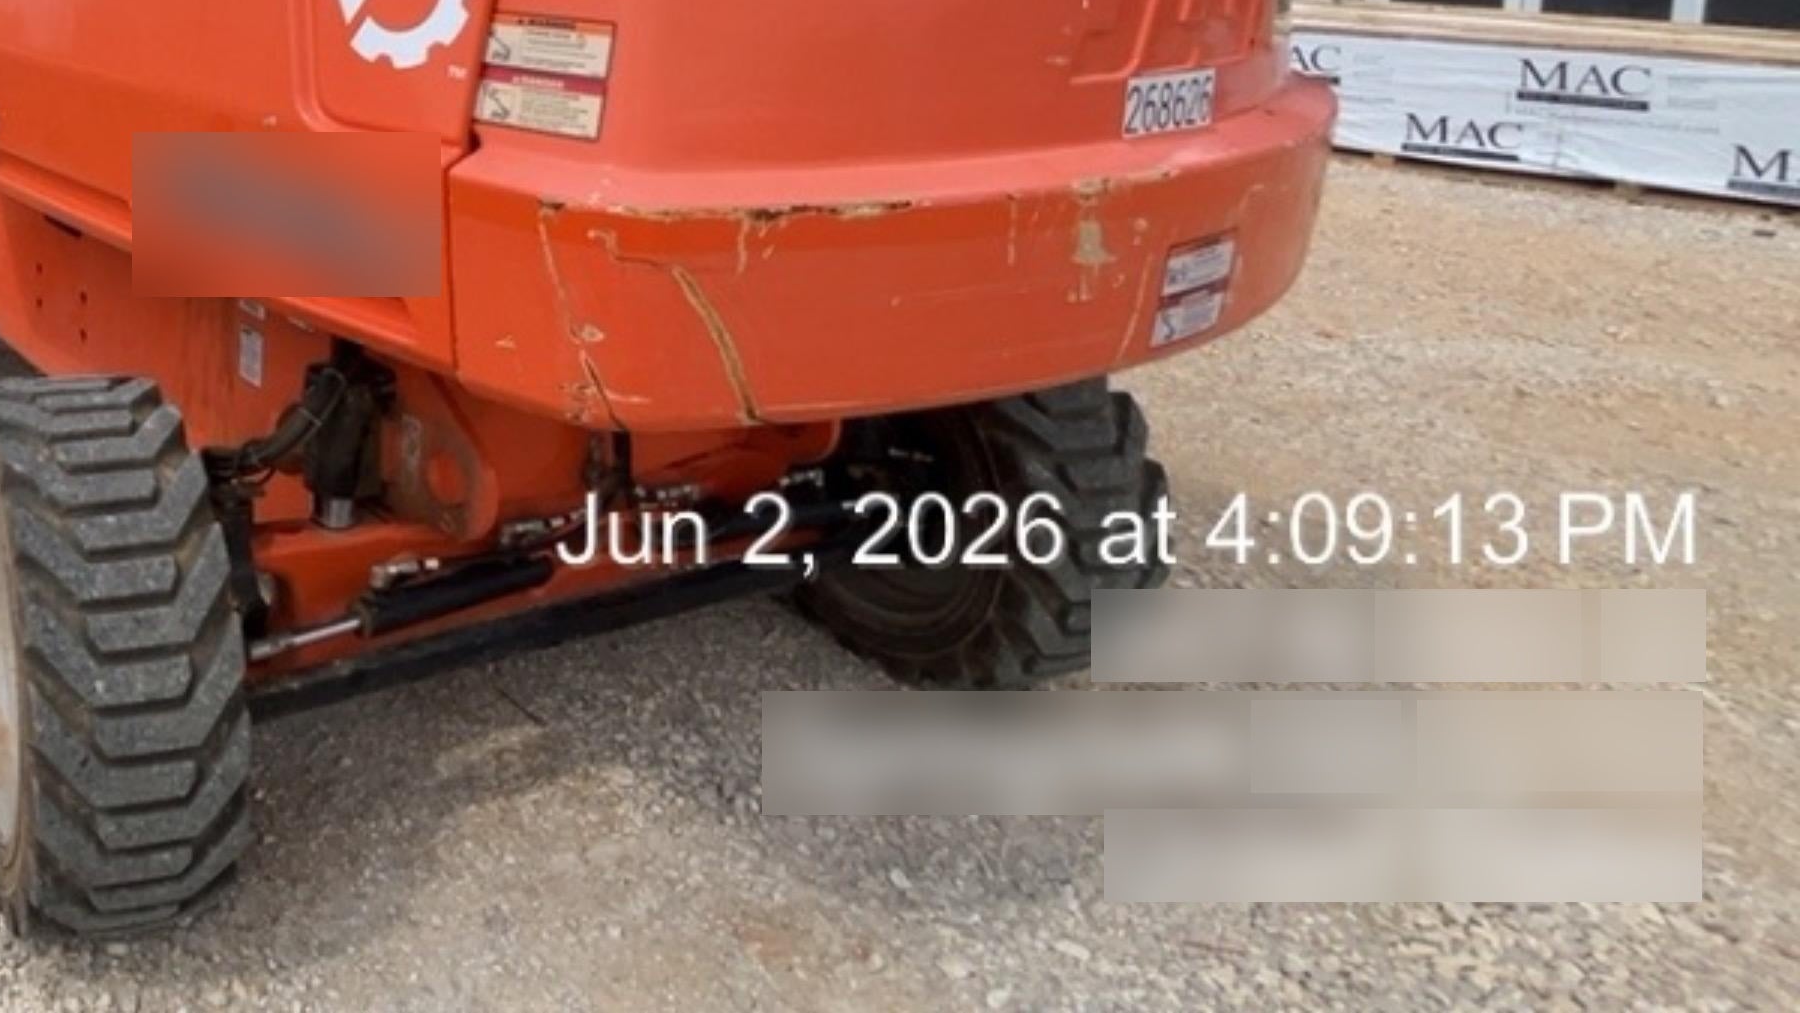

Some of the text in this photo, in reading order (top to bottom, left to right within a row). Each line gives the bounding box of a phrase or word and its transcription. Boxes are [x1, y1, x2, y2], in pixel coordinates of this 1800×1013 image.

[1292, 43, 1341, 73] AC
[1520, 57, 1652, 96] MAC
[1124, 75, 1213, 134] 268626
[1405, 111, 1523, 150] MAC
